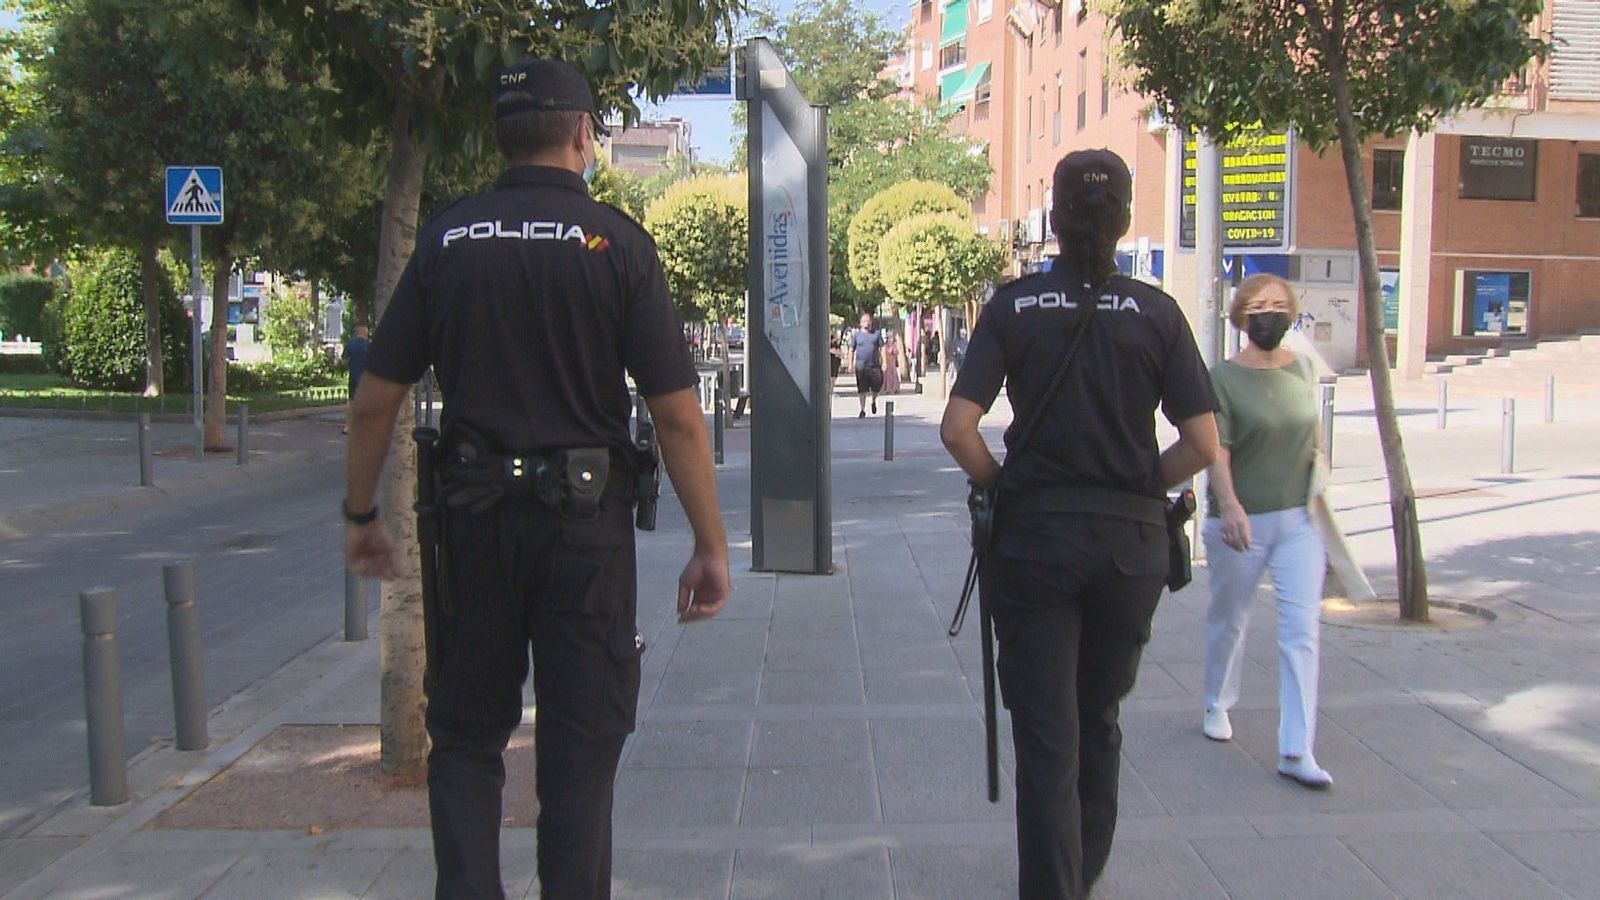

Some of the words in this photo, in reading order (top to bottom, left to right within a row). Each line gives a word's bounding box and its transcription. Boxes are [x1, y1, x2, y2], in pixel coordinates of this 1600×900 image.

[500, 72, 527, 85] CNP
[1470, 145, 1525, 158] TECMO
[1083, 172, 1108, 183] CNP
[443, 221, 587, 247] POLICIA
[1227, 228, 1275, 240] COVID-19
[768, 212, 788, 307] Avenidas
[1014, 291, 1140, 313] POLCIA
